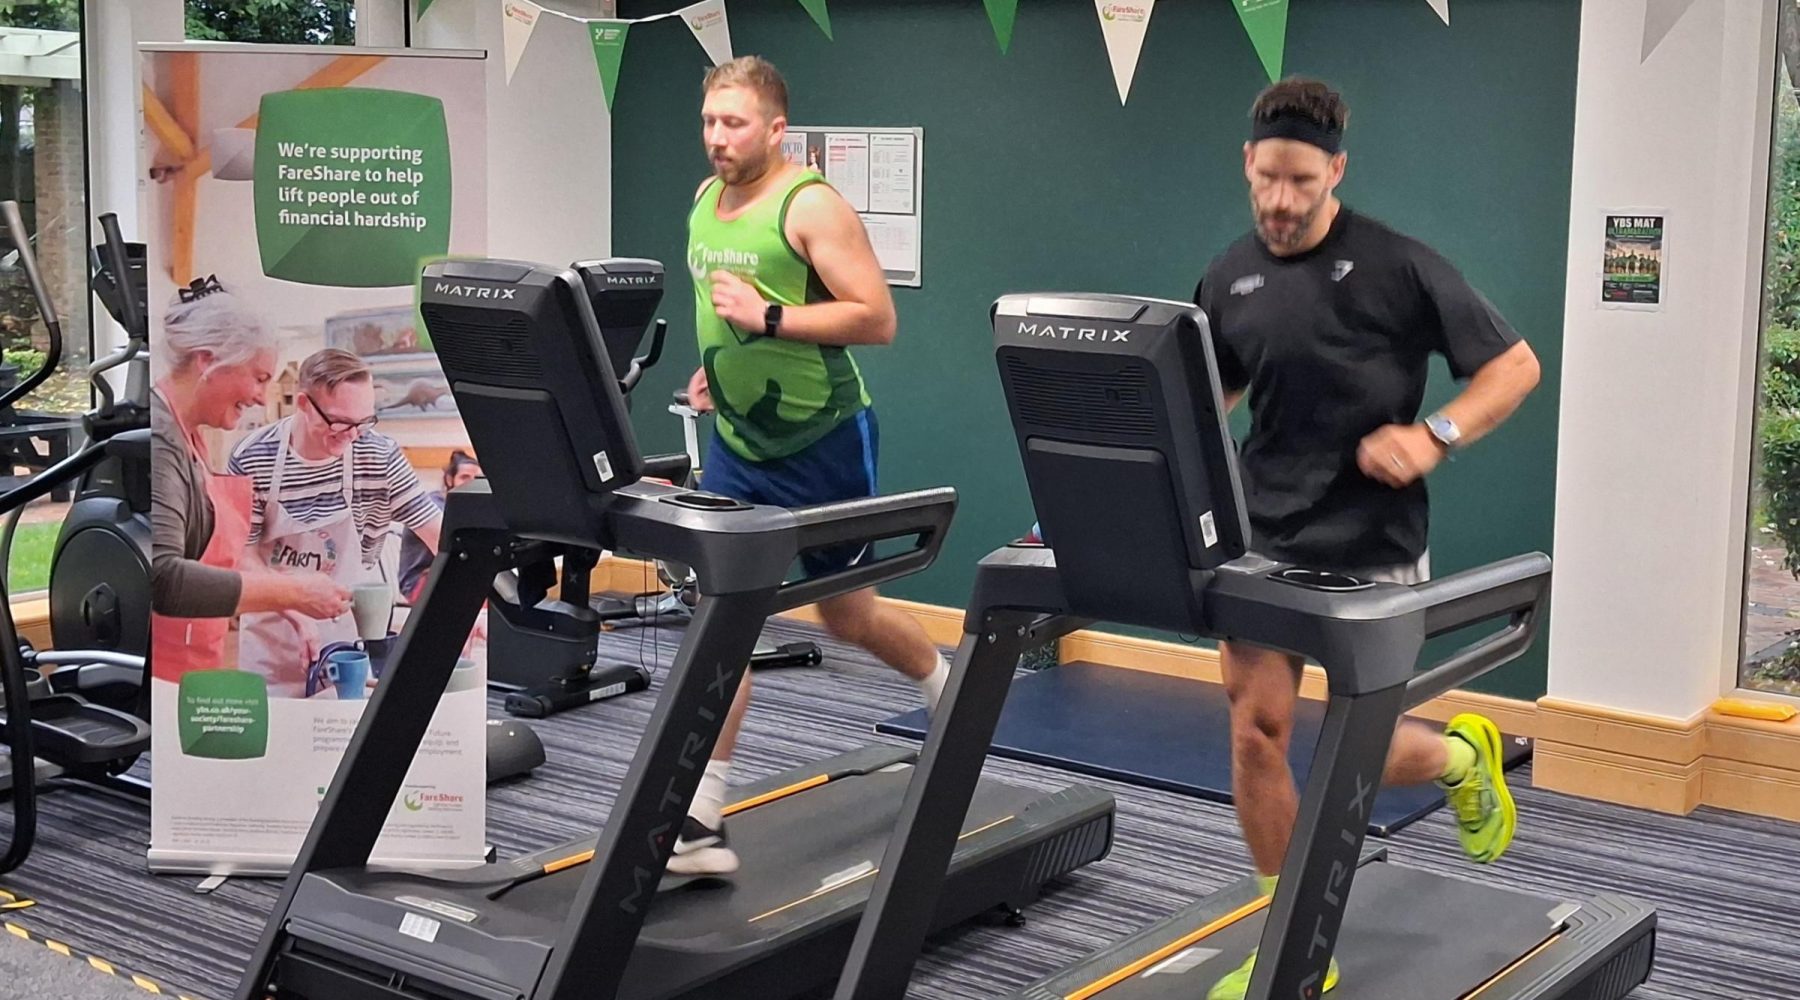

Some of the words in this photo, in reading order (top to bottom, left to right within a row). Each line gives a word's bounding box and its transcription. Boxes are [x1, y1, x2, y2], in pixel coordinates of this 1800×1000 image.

[278, 142, 326, 158] We're
[330, 144, 423, 165] supporting
[278, 165, 361, 182] FareShare
[365, 169, 382, 183] to
[385, 166, 424, 187] help
[278, 186, 303, 203] lift
[307, 189, 367, 210] people
[370, 192, 397, 206] out
[401, 189, 420, 206] of
[278, 209, 351, 227] financial
[354, 211, 427, 232] hardship
[1613, 217, 1632, 227] YBS
[1634, 217, 1656, 228] MAT
[434, 282, 517, 300] MATRIX
[607, 275, 656, 285] MATRIX
[1017, 322, 1132, 343] MATRIX
[278, 545, 321, 571] FARM
[420, 792, 464, 803] FareShare
[618, 661, 734, 915] MATRIX
